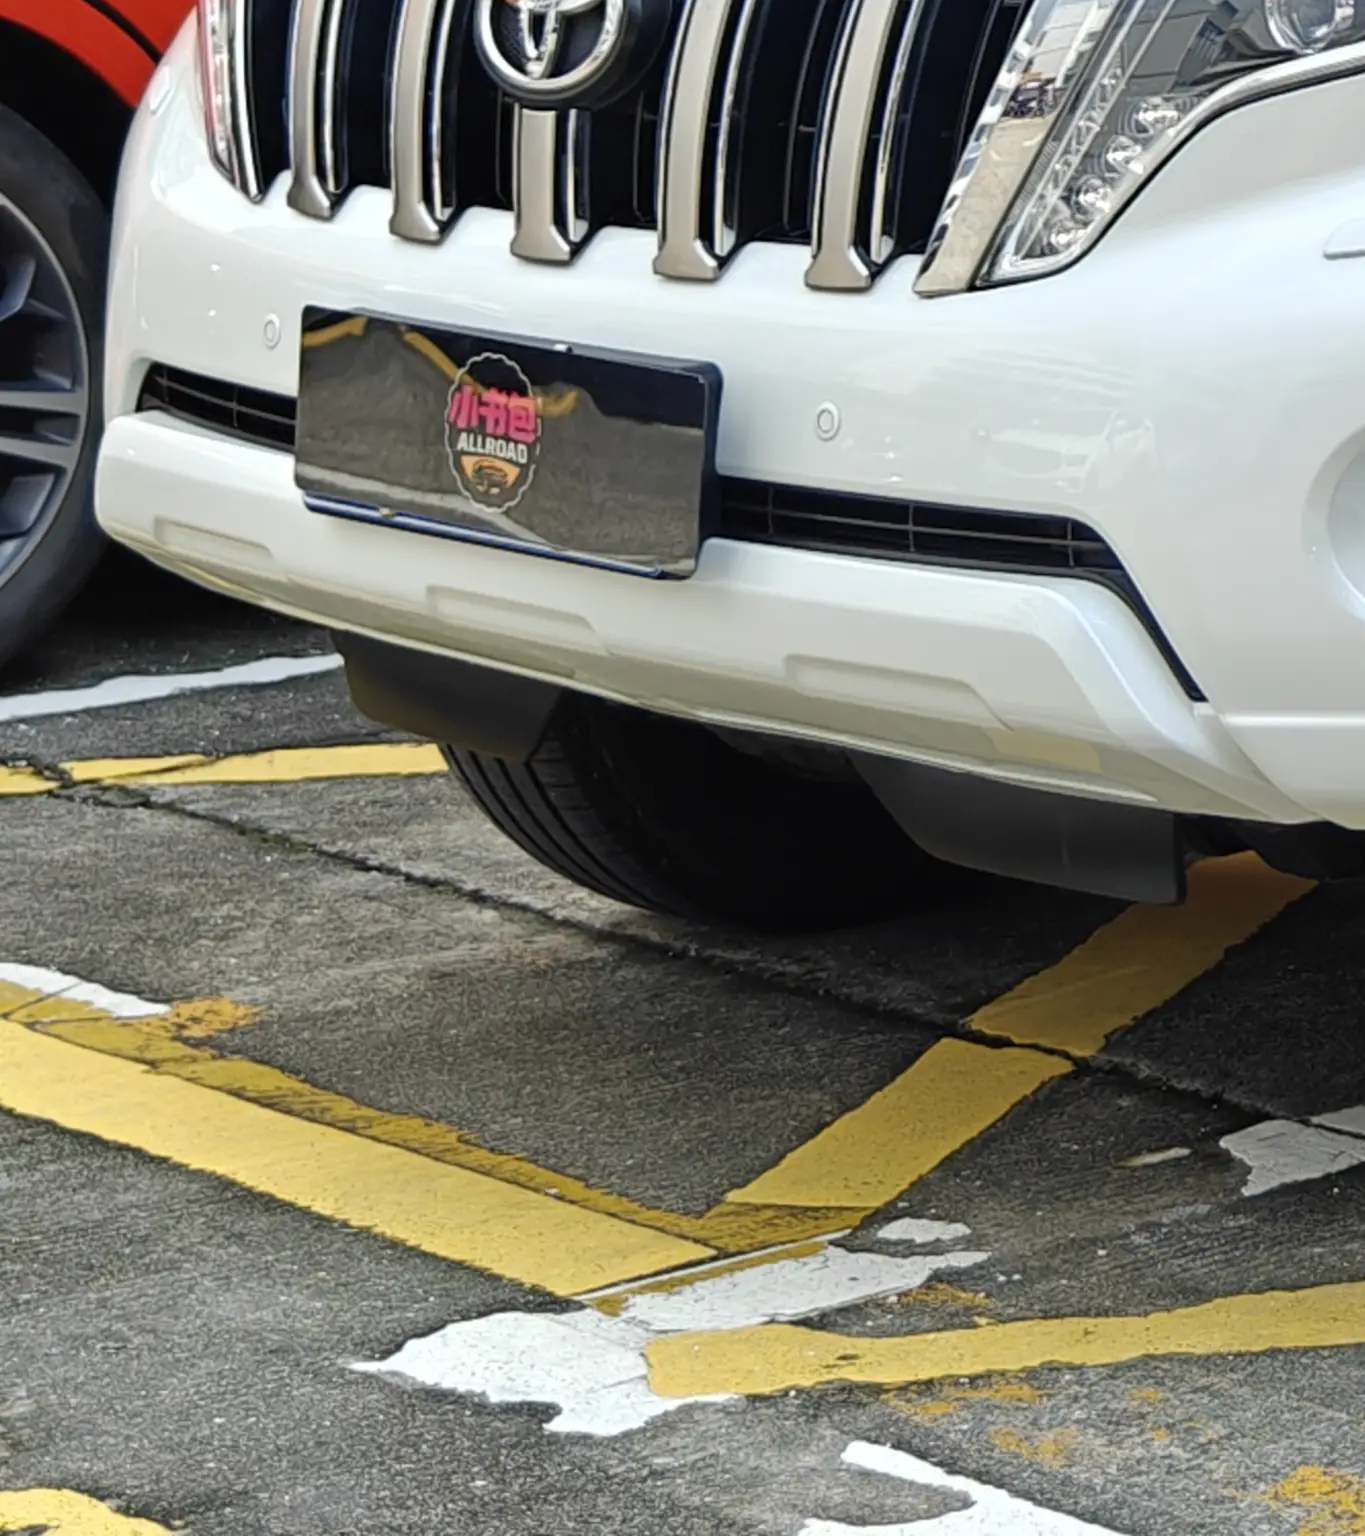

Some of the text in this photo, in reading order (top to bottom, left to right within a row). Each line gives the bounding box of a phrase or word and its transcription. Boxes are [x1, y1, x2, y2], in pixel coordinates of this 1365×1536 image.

[449, 384, 537, 444] 小书包
[455, 431, 529, 463] ALLROAD
